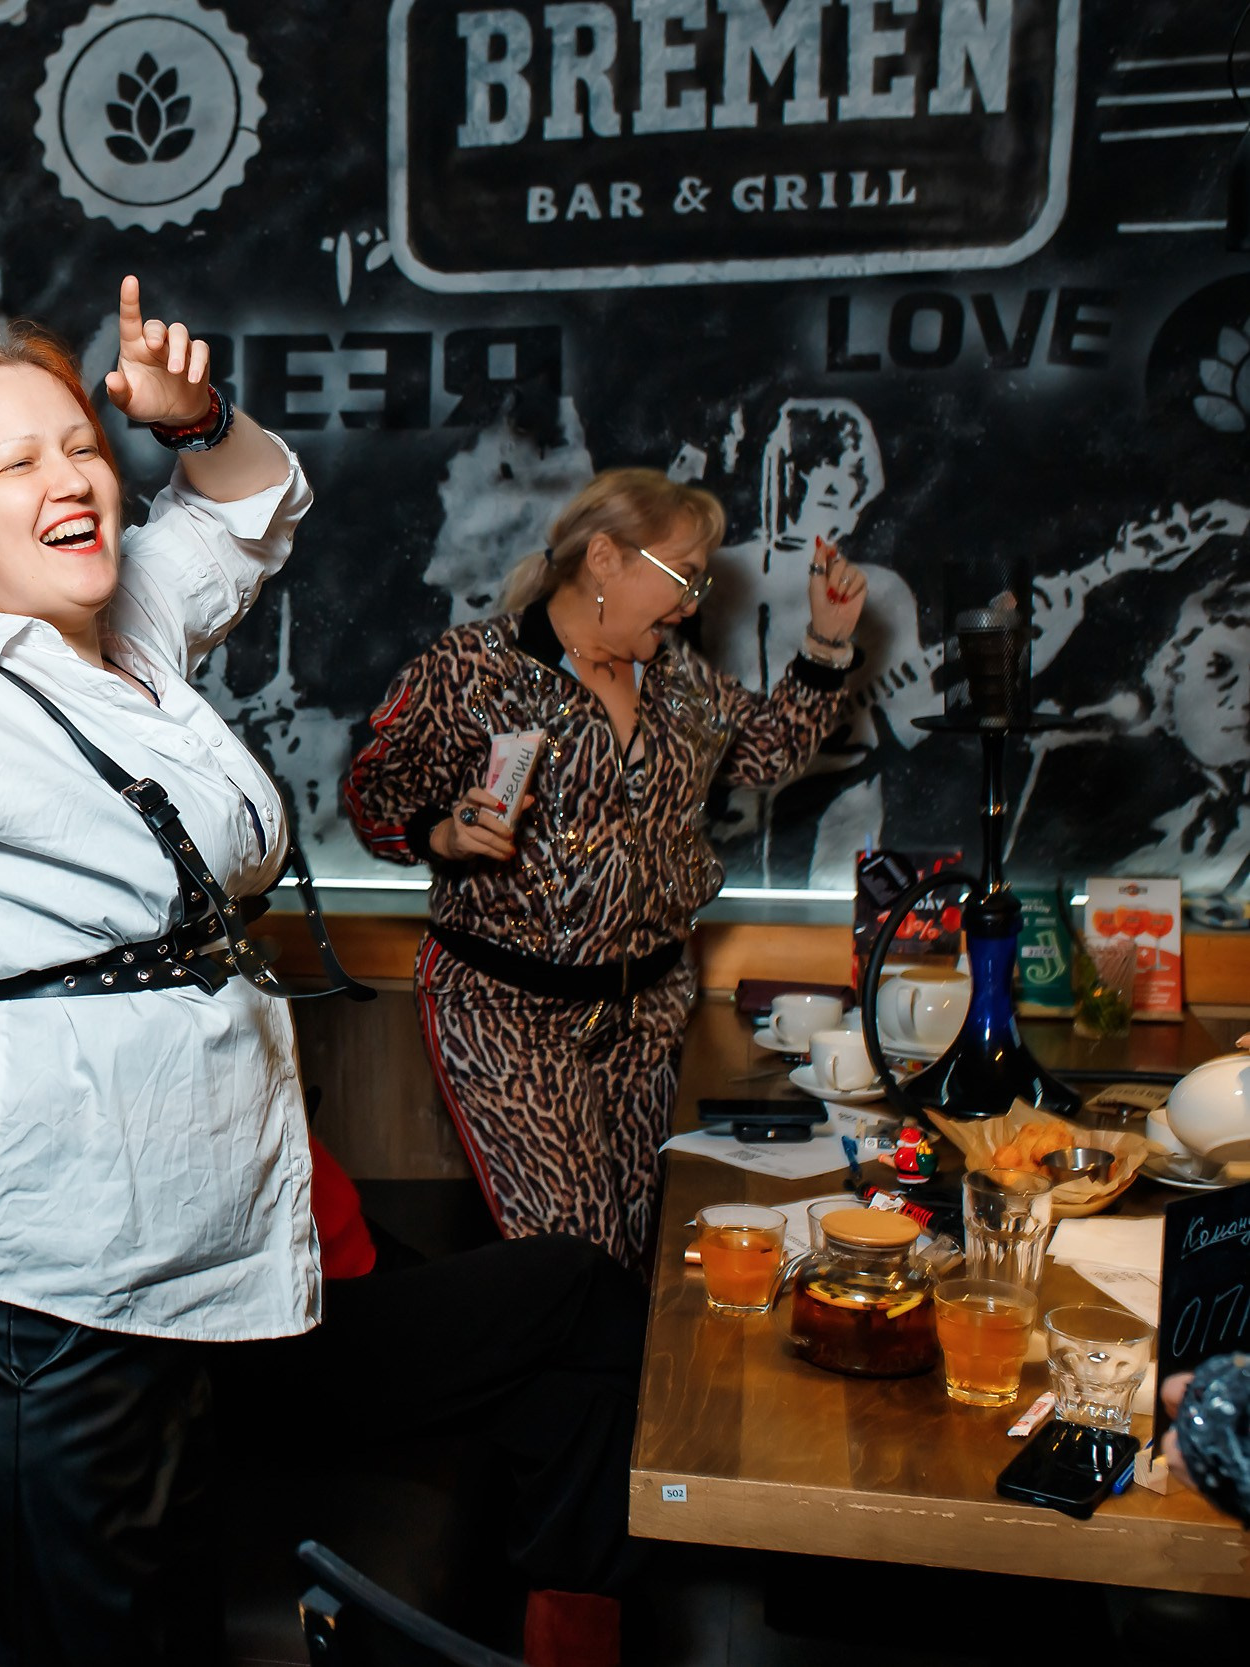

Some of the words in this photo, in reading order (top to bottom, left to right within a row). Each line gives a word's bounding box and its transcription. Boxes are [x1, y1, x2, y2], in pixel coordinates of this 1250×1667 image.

[456, 0, 1014, 148] BREMEN
[527, 182, 643, 223] BAR
[673, 176, 712, 213] &
[732, 169, 917, 211] GRILL
[825, 287, 1120, 373] LOVE
[496, 747, 534, 820] зелин
[1172, 1284, 1250, 1357] ОП
